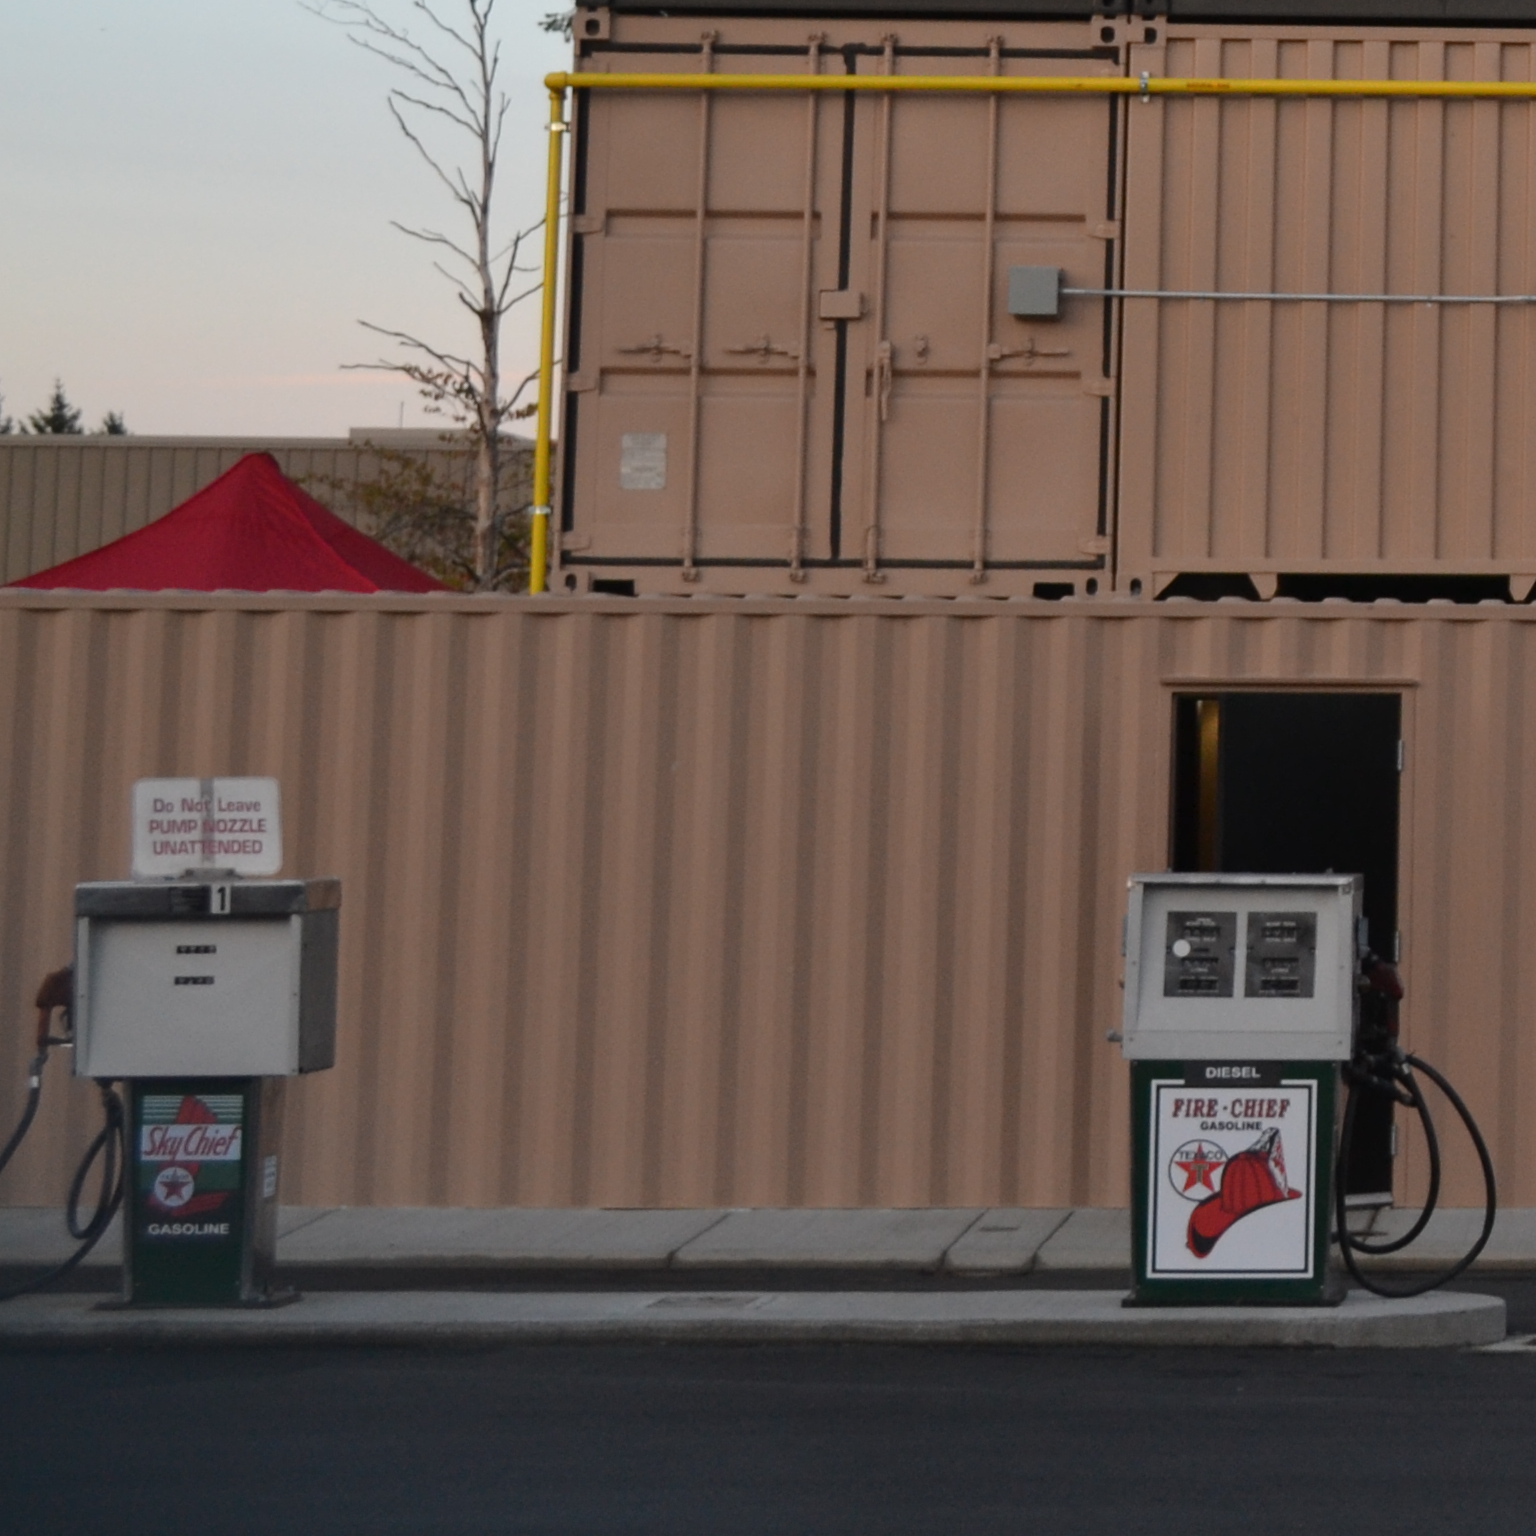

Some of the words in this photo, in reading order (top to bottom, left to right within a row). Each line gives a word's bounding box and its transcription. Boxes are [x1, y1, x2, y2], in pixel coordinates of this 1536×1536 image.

[152, 798, 174, 813] Do
[181, 798, 211, 813] Not
[217, 798, 261, 812] Leave
[149, 819, 198, 834] PUMP
[203, 818, 267, 833] NOZZLE
[152, 840, 263, 855] UNATTENDED
[217, 886, 226, 911] 1
[1205, 1067, 1261, 1078] DIESEL
[1200, 1121, 1263, 1131] GASOLINE
[144, 1125, 185, 1160] Sky
[184, 1125, 242, 1156] Chief
[148, 1223, 230, 1235] GASOLINE
